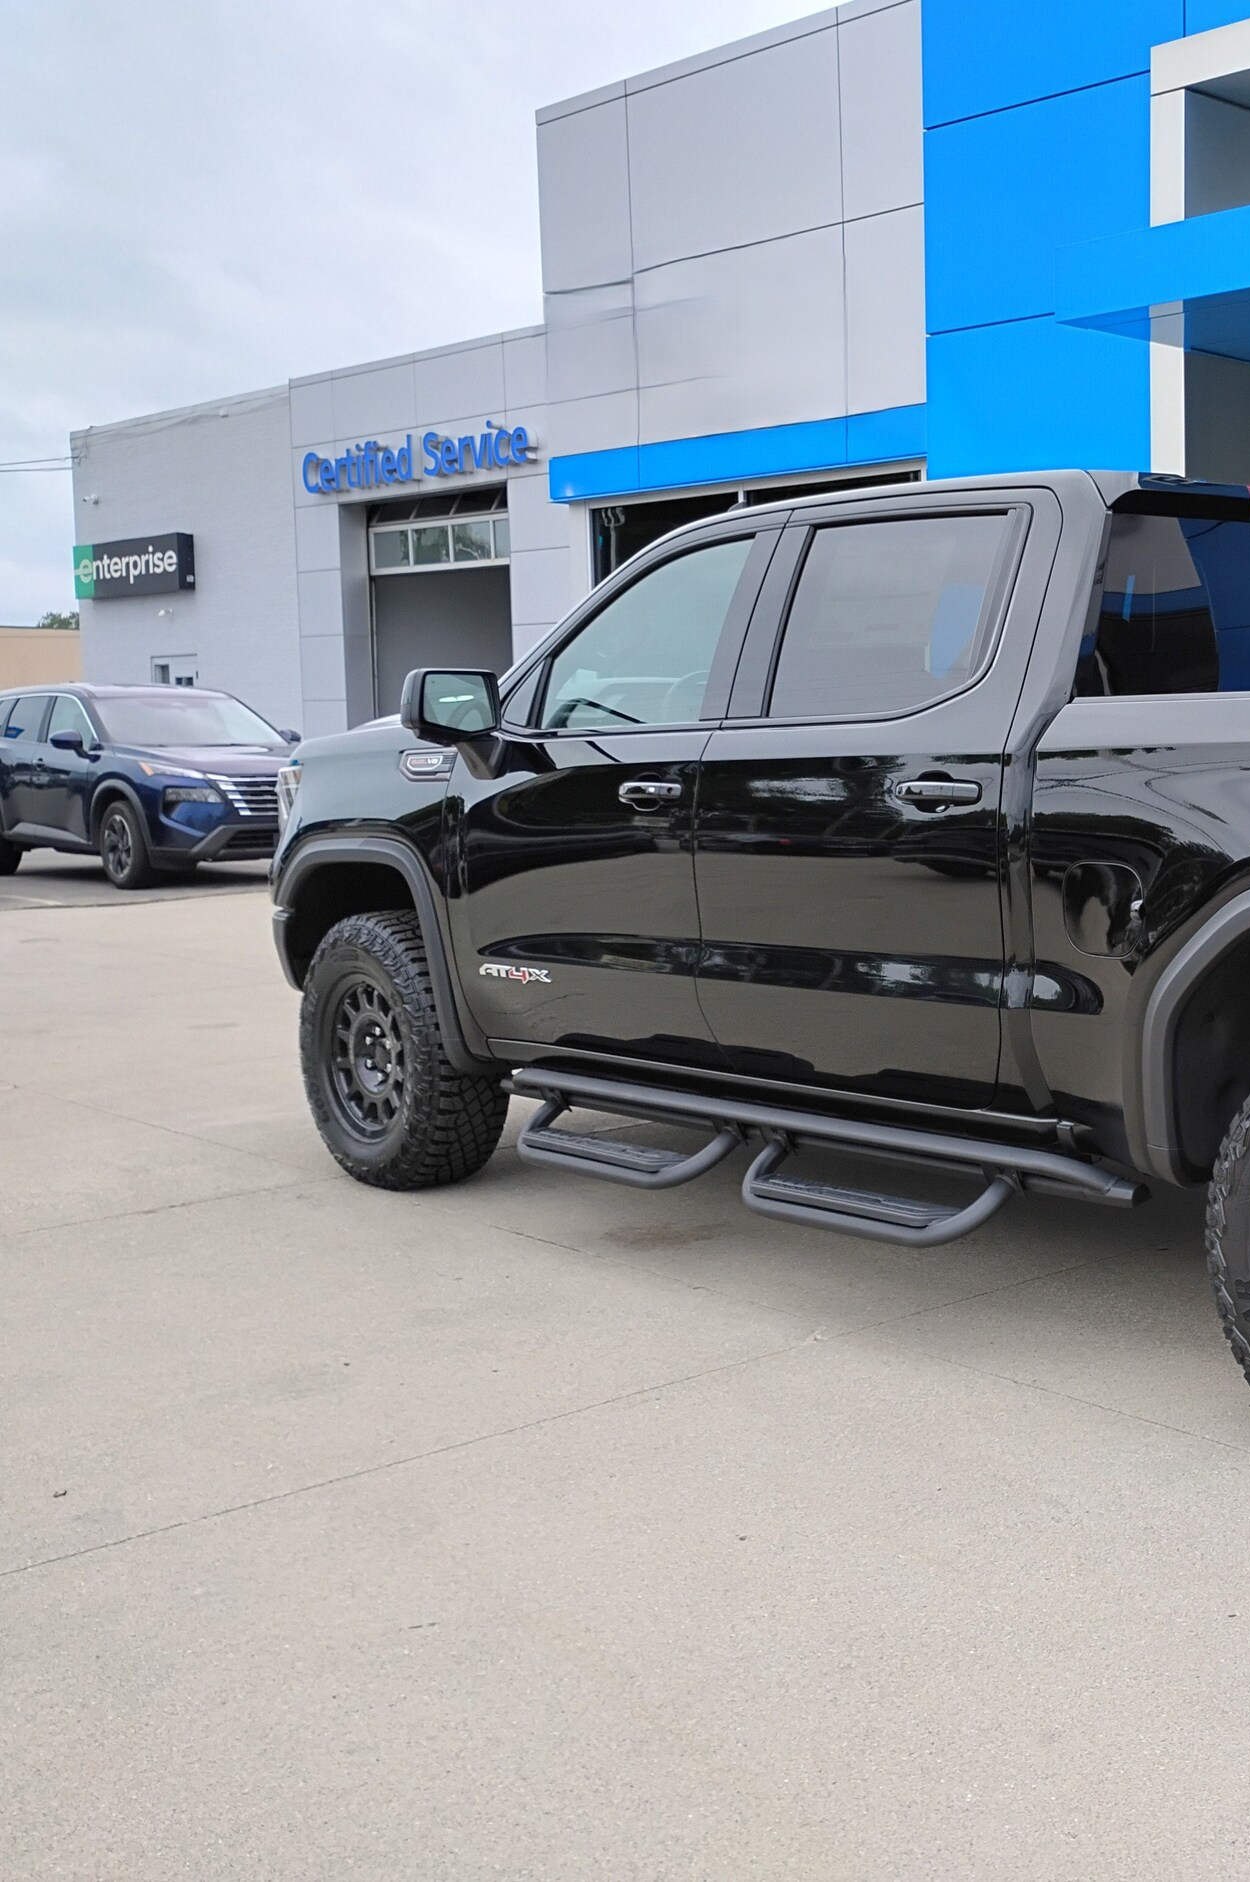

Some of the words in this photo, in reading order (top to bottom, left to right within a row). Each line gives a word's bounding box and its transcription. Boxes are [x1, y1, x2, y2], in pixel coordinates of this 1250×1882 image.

[302, 440, 412, 494] Certified
[422, 419, 529, 477] Service
[75, 545, 178, 584] enterprise
[479, 963, 552, 985] AT4X
